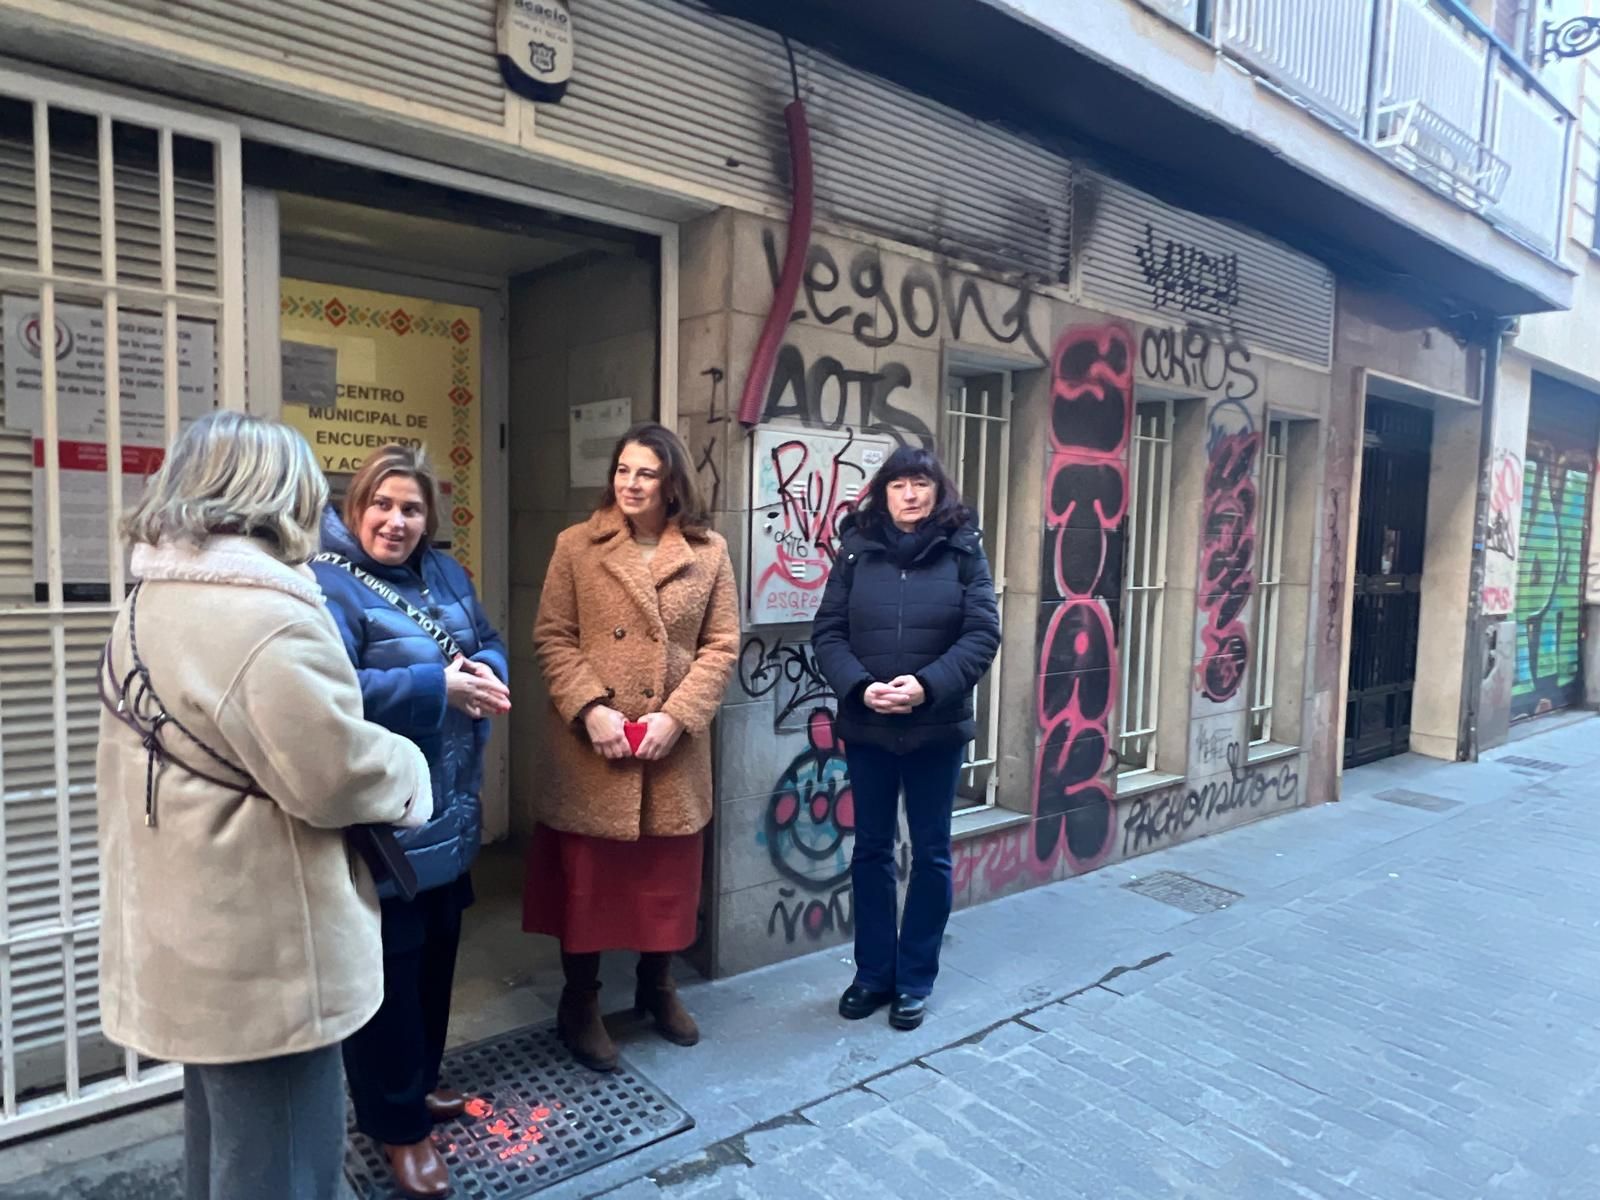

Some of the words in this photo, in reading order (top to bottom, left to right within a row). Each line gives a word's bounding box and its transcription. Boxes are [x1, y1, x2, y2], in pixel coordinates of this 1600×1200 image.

[336, 384, 405, 404] CENTRO
[309, 406, 401, 427] MUNICIPAL
[406, 414, 428, 429] DE
[323, 456, 334, 468] Y
[405, 603, 444, 641] LOLA
